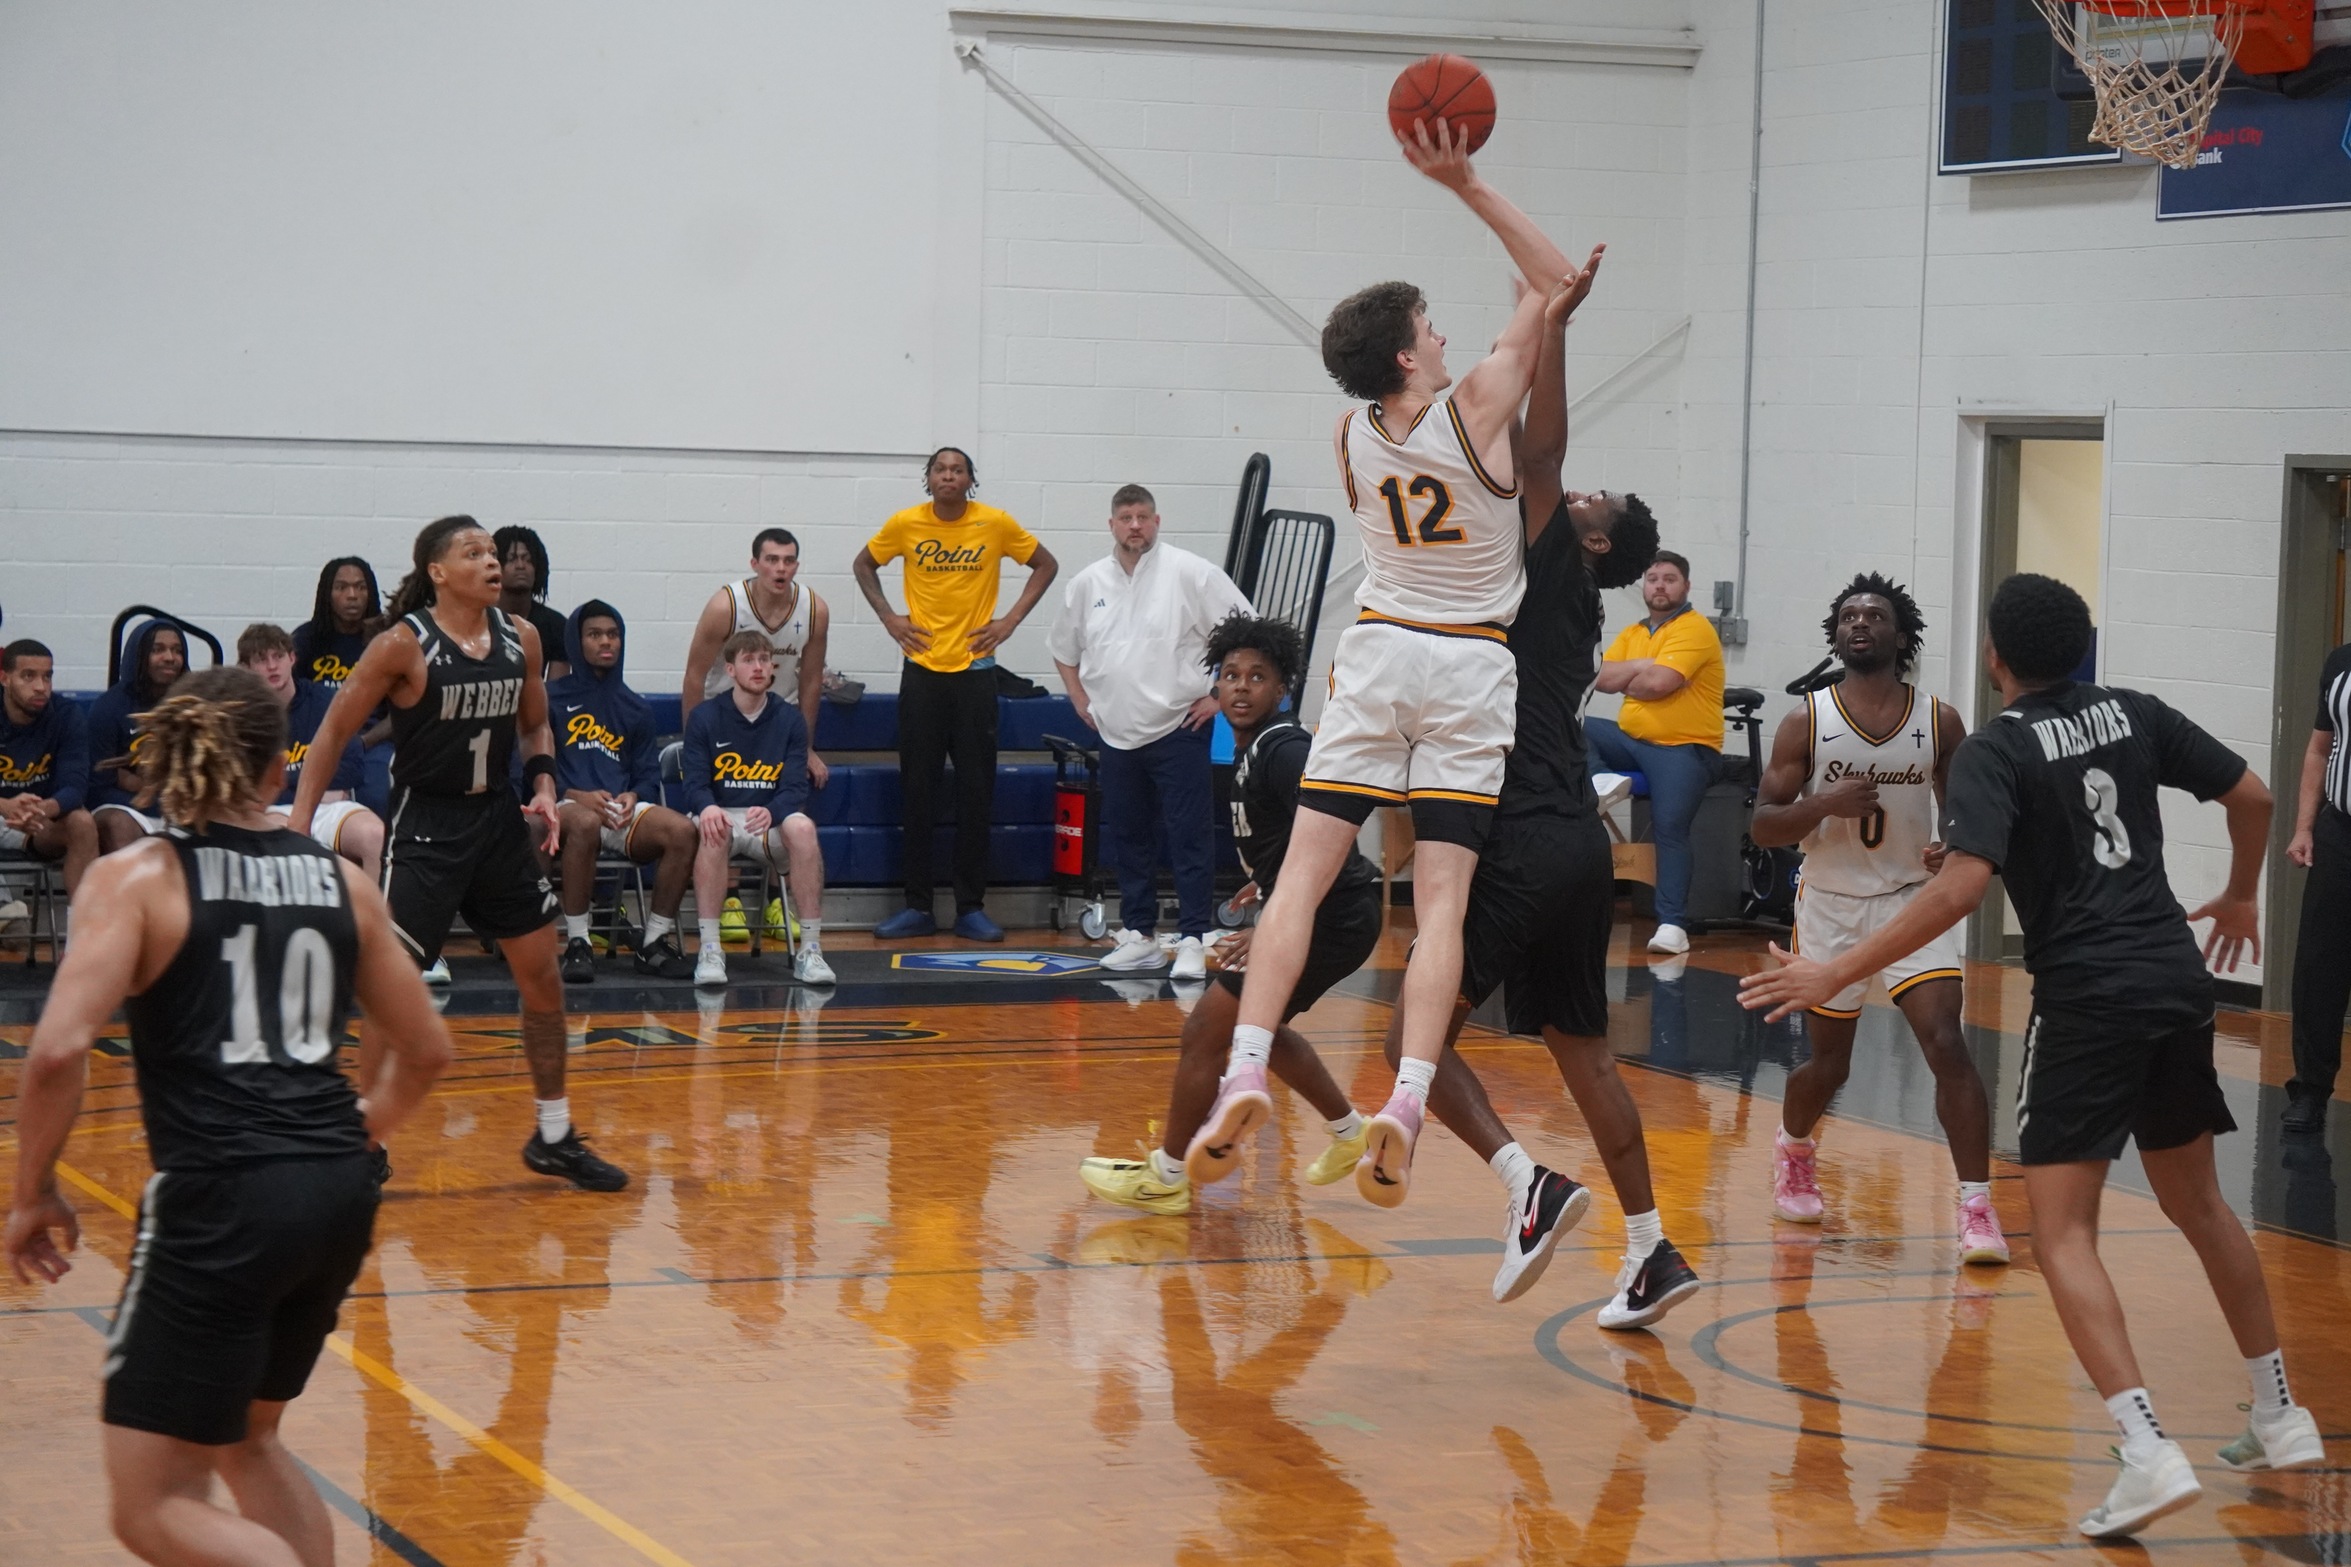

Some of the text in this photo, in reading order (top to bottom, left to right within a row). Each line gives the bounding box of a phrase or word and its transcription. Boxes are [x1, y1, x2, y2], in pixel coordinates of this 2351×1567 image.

[2190, 126, 2263, 150] pital City
[2196, 147, 2223, 165] ank
[1377, 473, 1468, 547] 12
[915, 539, 986, 567] Point
[565, 713, 625, 751] Point
[464, 728, 491, 795] 1
[714, 752, 784, 781] Point
[1860, 804, 1888, 851] 0
[220, 924, 335, 1064] 10
